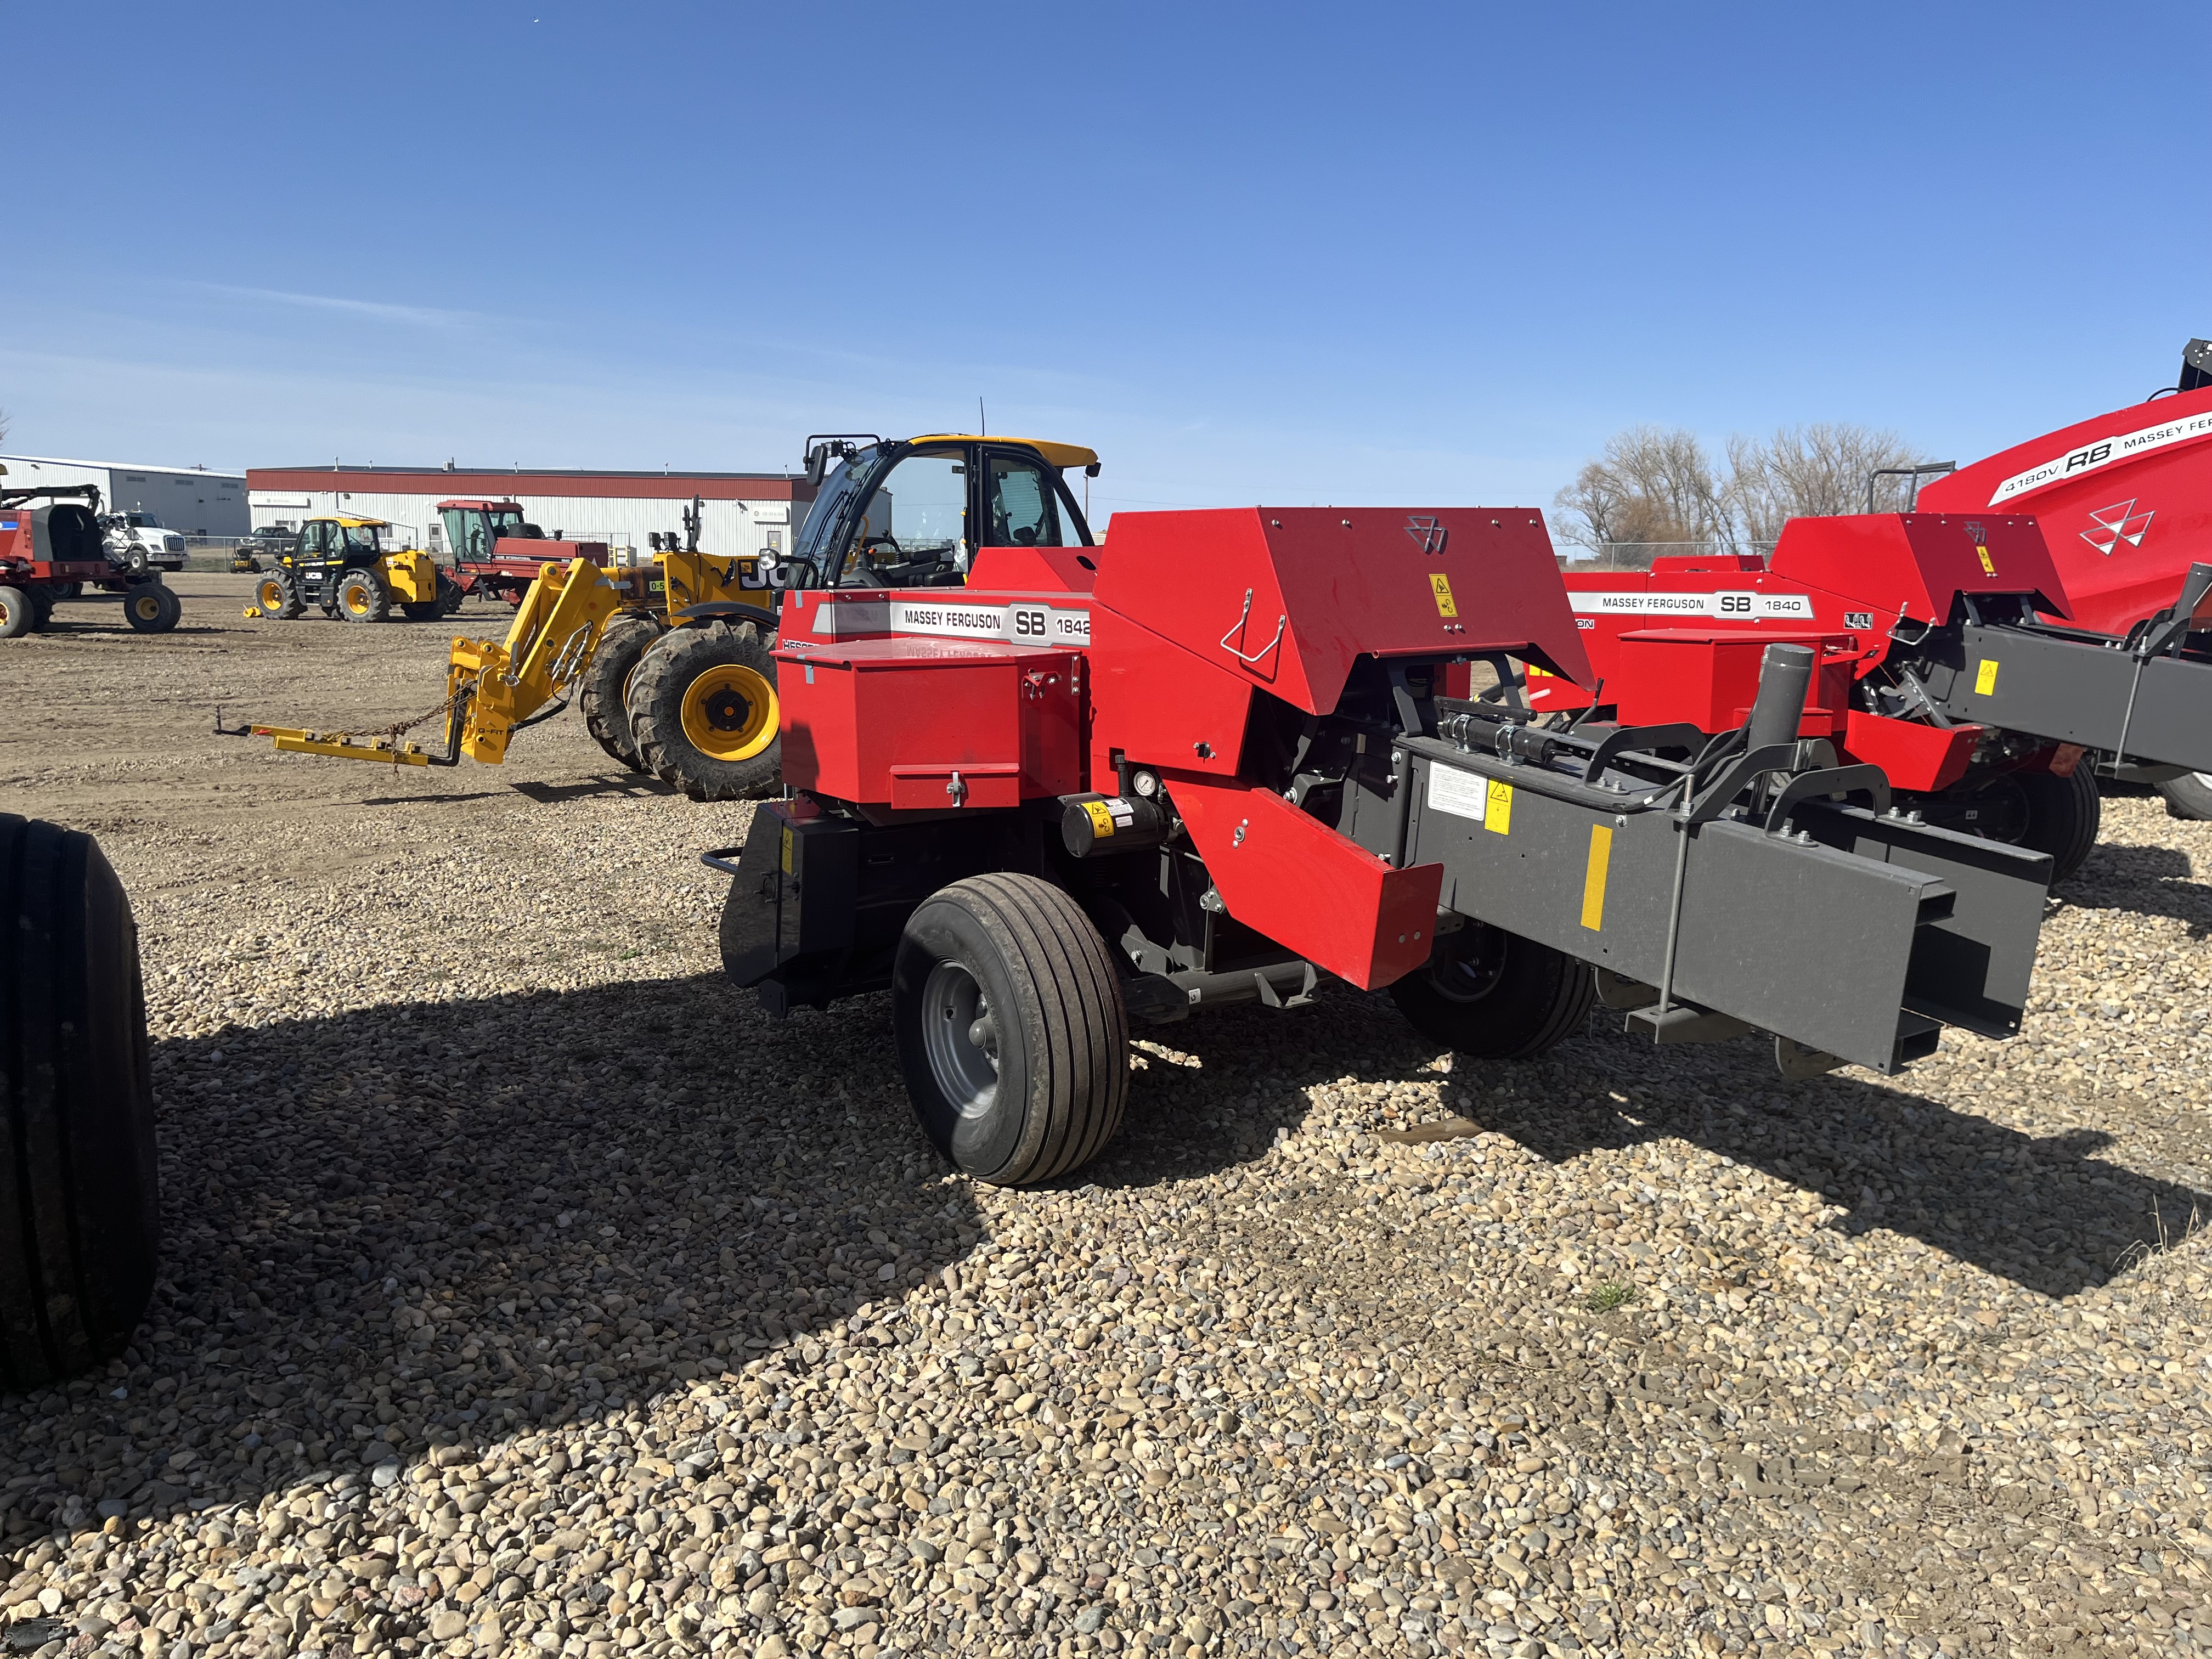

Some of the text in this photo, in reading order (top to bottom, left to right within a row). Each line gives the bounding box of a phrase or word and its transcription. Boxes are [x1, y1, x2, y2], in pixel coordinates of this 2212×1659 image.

[2005, 465, 2059, 492] 4180V
[2066, 443, 2112, 472] RB
[2124, 425, 2183, 449] MASSEY
[1602, 596, 1801, 612] MASSEY FERGUSON SB 1840
[905, 610, 1090, 635] MASSEY FERGUSON SB 1842
